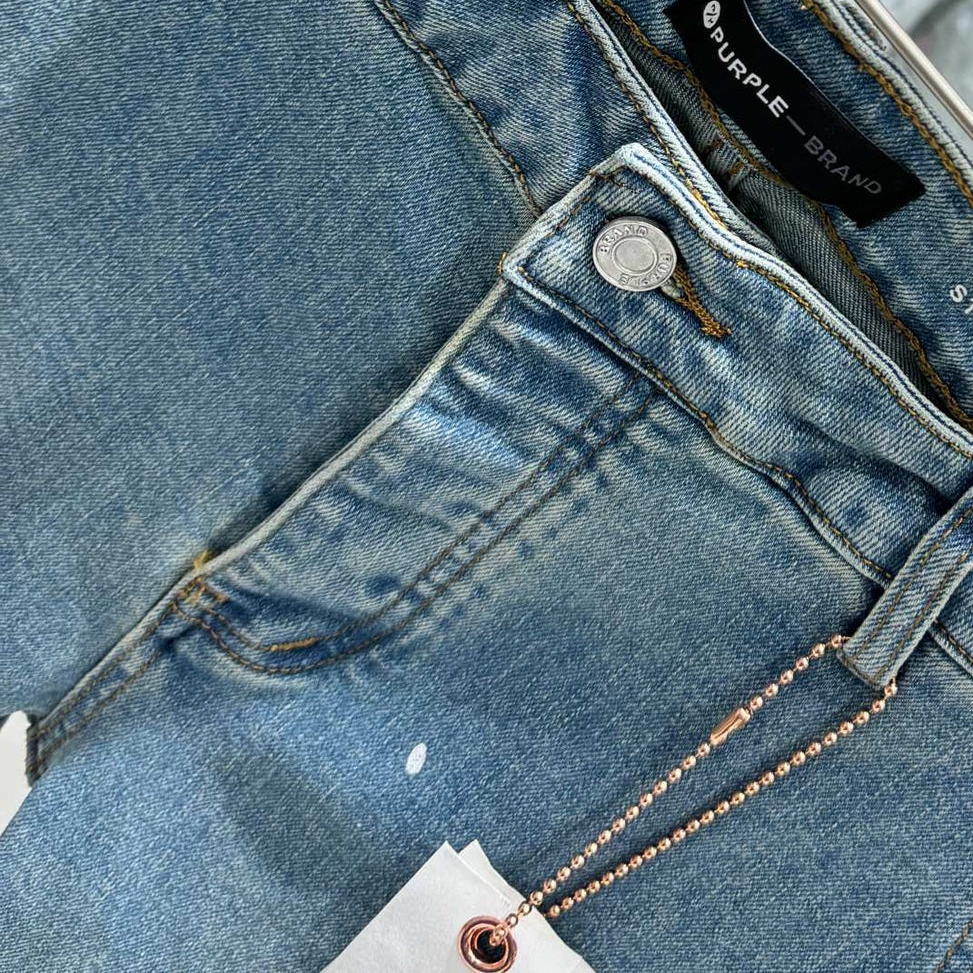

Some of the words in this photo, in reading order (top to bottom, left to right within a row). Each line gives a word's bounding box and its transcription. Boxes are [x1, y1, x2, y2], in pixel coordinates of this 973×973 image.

[709, 27, 789, 118] PURPLE
[804, 135, 883, 195] BRAND
[600, 225, 648, 256] BRAND
[620, 253, 672, 285] PURPLE
